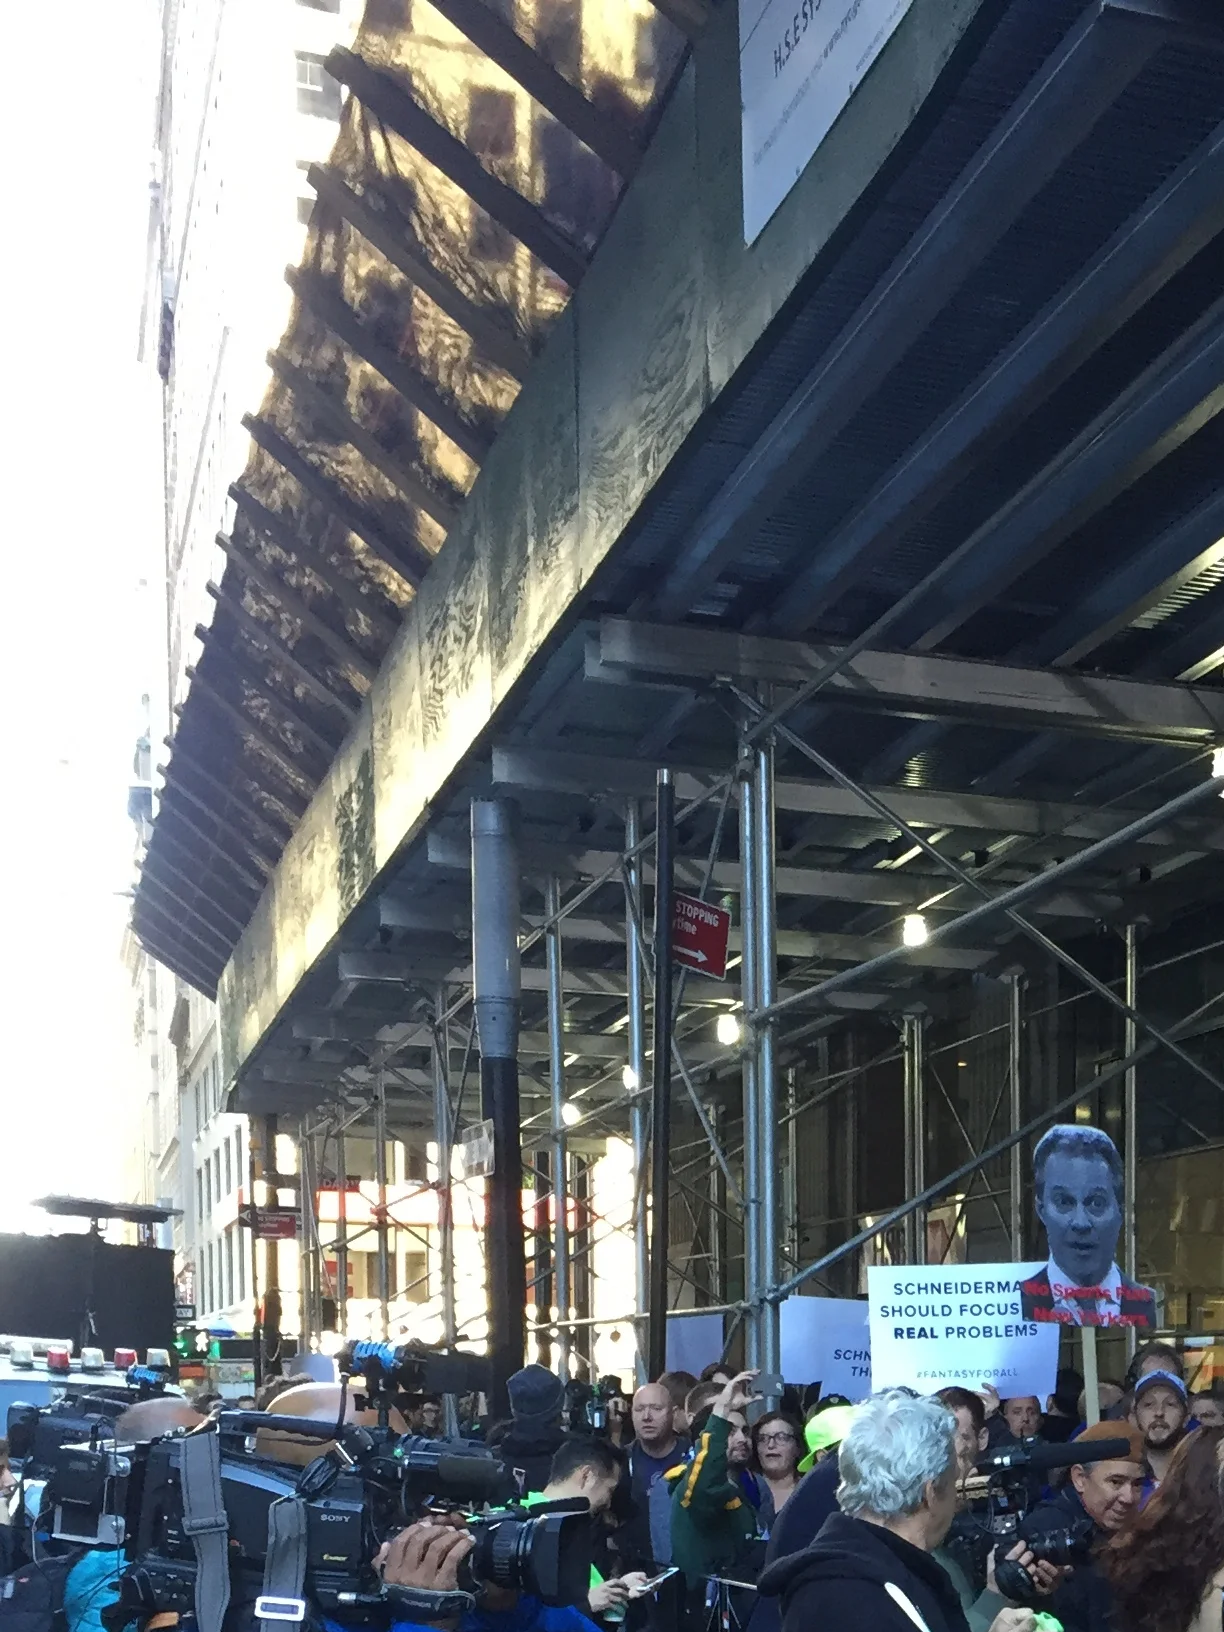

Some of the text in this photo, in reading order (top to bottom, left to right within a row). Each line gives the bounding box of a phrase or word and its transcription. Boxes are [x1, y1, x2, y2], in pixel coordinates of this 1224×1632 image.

[676, 900, 719, 927] STOPPING
[673, 917, 697, 935] time
[893, 1281, 1021, 1296] SCHNEIDERMA
[880, 1303, 1020, 1318] SHOULD FOCUS
[894, 1324, 1039, 1340] REAL PROBLEMS
[320, 1513, 351, 1523] SONY
